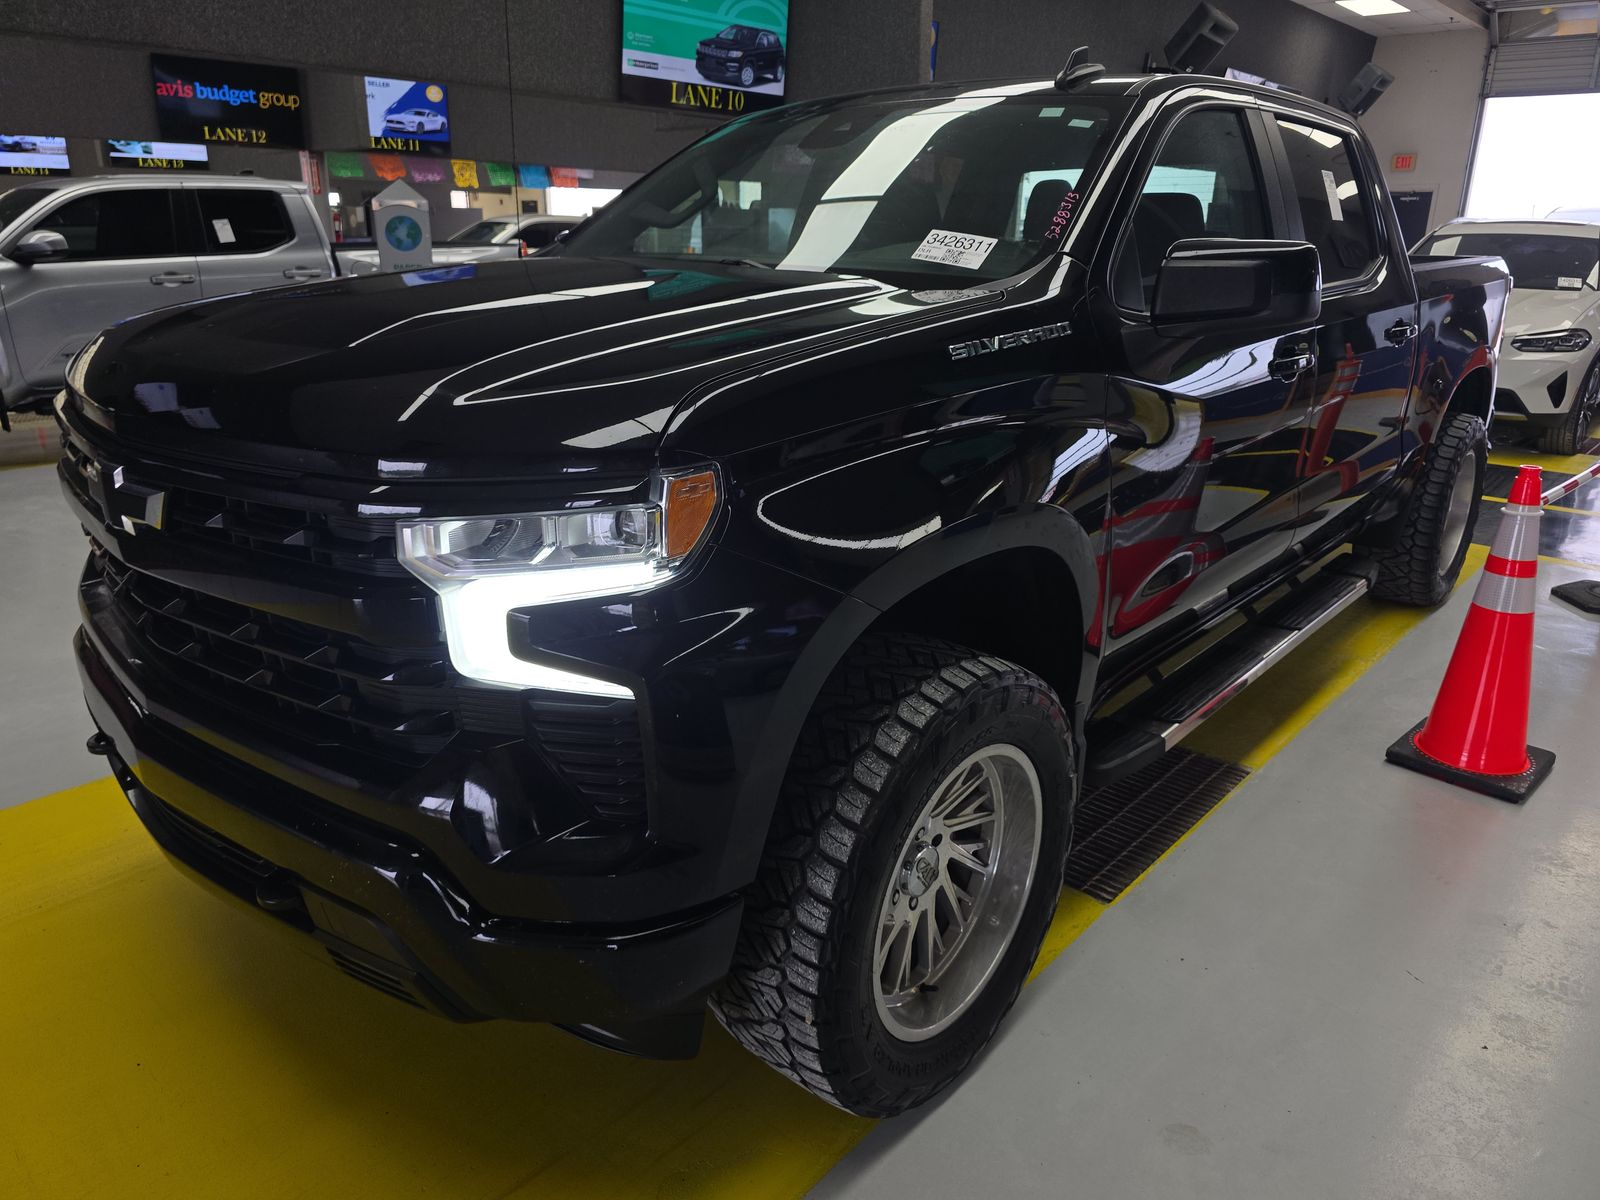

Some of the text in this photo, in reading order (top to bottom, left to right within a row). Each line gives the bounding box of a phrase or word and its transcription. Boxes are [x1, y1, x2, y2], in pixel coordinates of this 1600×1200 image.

[156, 80, 300, 110] avis budget group
[671, 82, 745, 111] LANE 10
[203, 125, 267, 143] LANE 12
[368, 136, 420, 151] LANE 11
[10, 166, 38, 175] LANE
[138, 157, 184, 168] LANE 13
[926, 233, 994, 254] 3426311
[948, 321, 1072, 360] SILVERADO
